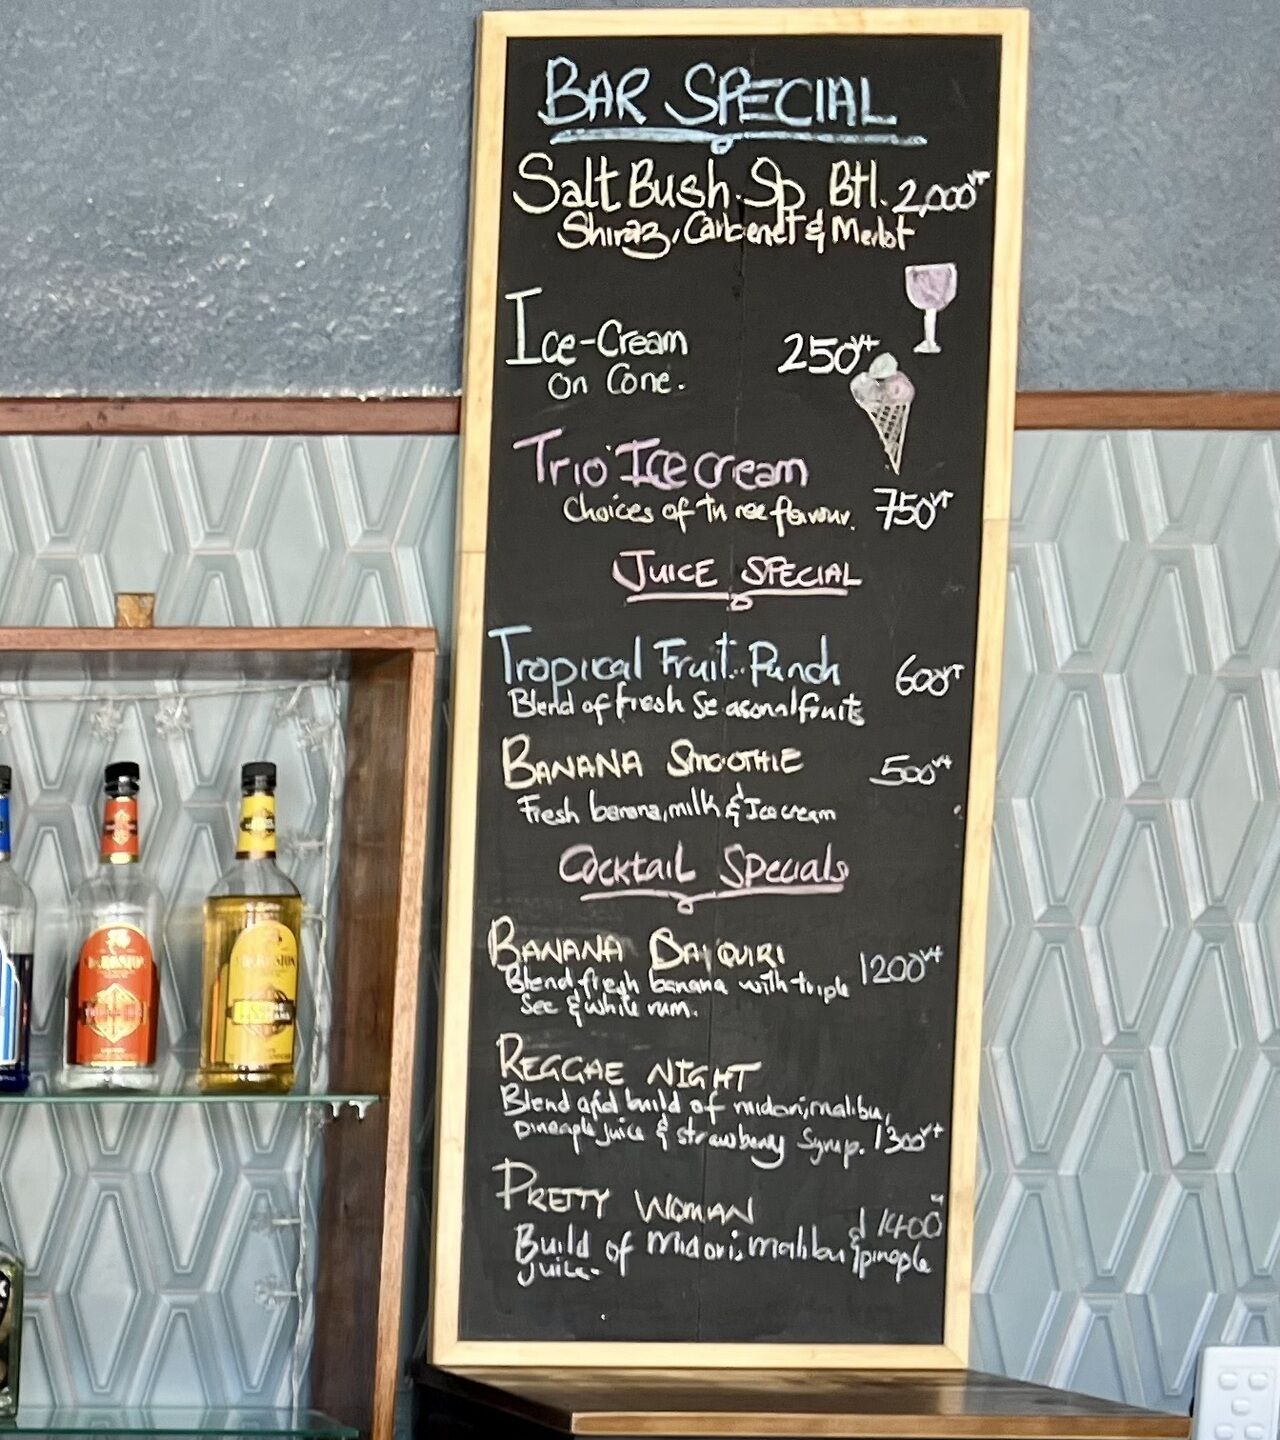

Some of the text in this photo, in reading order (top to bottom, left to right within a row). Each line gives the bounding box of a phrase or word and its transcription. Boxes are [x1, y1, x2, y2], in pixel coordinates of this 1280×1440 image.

[538, 57, 898, 126] BAR SPECIAL
[513, 152, 622, 214] Salt
[805, 208, 824, 254] &
[831, 213, 916, 251] Merlot
[505, 287, 688, 366] Ice-Cream
[513, 428, 608, 488] Trio
[563, 491, 654, 523] Choices
[661, 496, 695, 534] of
[612, 549, 864, 593] JUICE SPECIAL
[488, 624, 643, 702] Tropical
[748, 634, 841, 688] Punch
[507, 686, 575, 718] Blend
[581, 692, 612, 726] of
[797, 691, 866, 727] fruits
[502, 732, 644, 790] BANANA
[517, 793, 581, 826] Fresh
[725, 781, 746, 828] &
[720, 842, 849, 888] Specials
[487, 915, 624, 972] BANANA
[504, 963, 573, 994] Blend
[648, 967, 729, 995] banana
[738, 969, 789, 996] with
[790, 970, 851, 1005] triple
[566, 987, 584, 1028] &
[496, 1032, 763, 1093] REGGAE NIGHT
[500, 1082, 571, 1117] Blend
[624, 1086, 682, 1114] build
[689, 1089, 727, 1126] of
[655, 1111, 669, 1152] &
[492, 1157, 755, 1227] PRETTY WOMAN
[514, 1222, 590, 1266] Build
[605, 1230, 634, 1278] of
